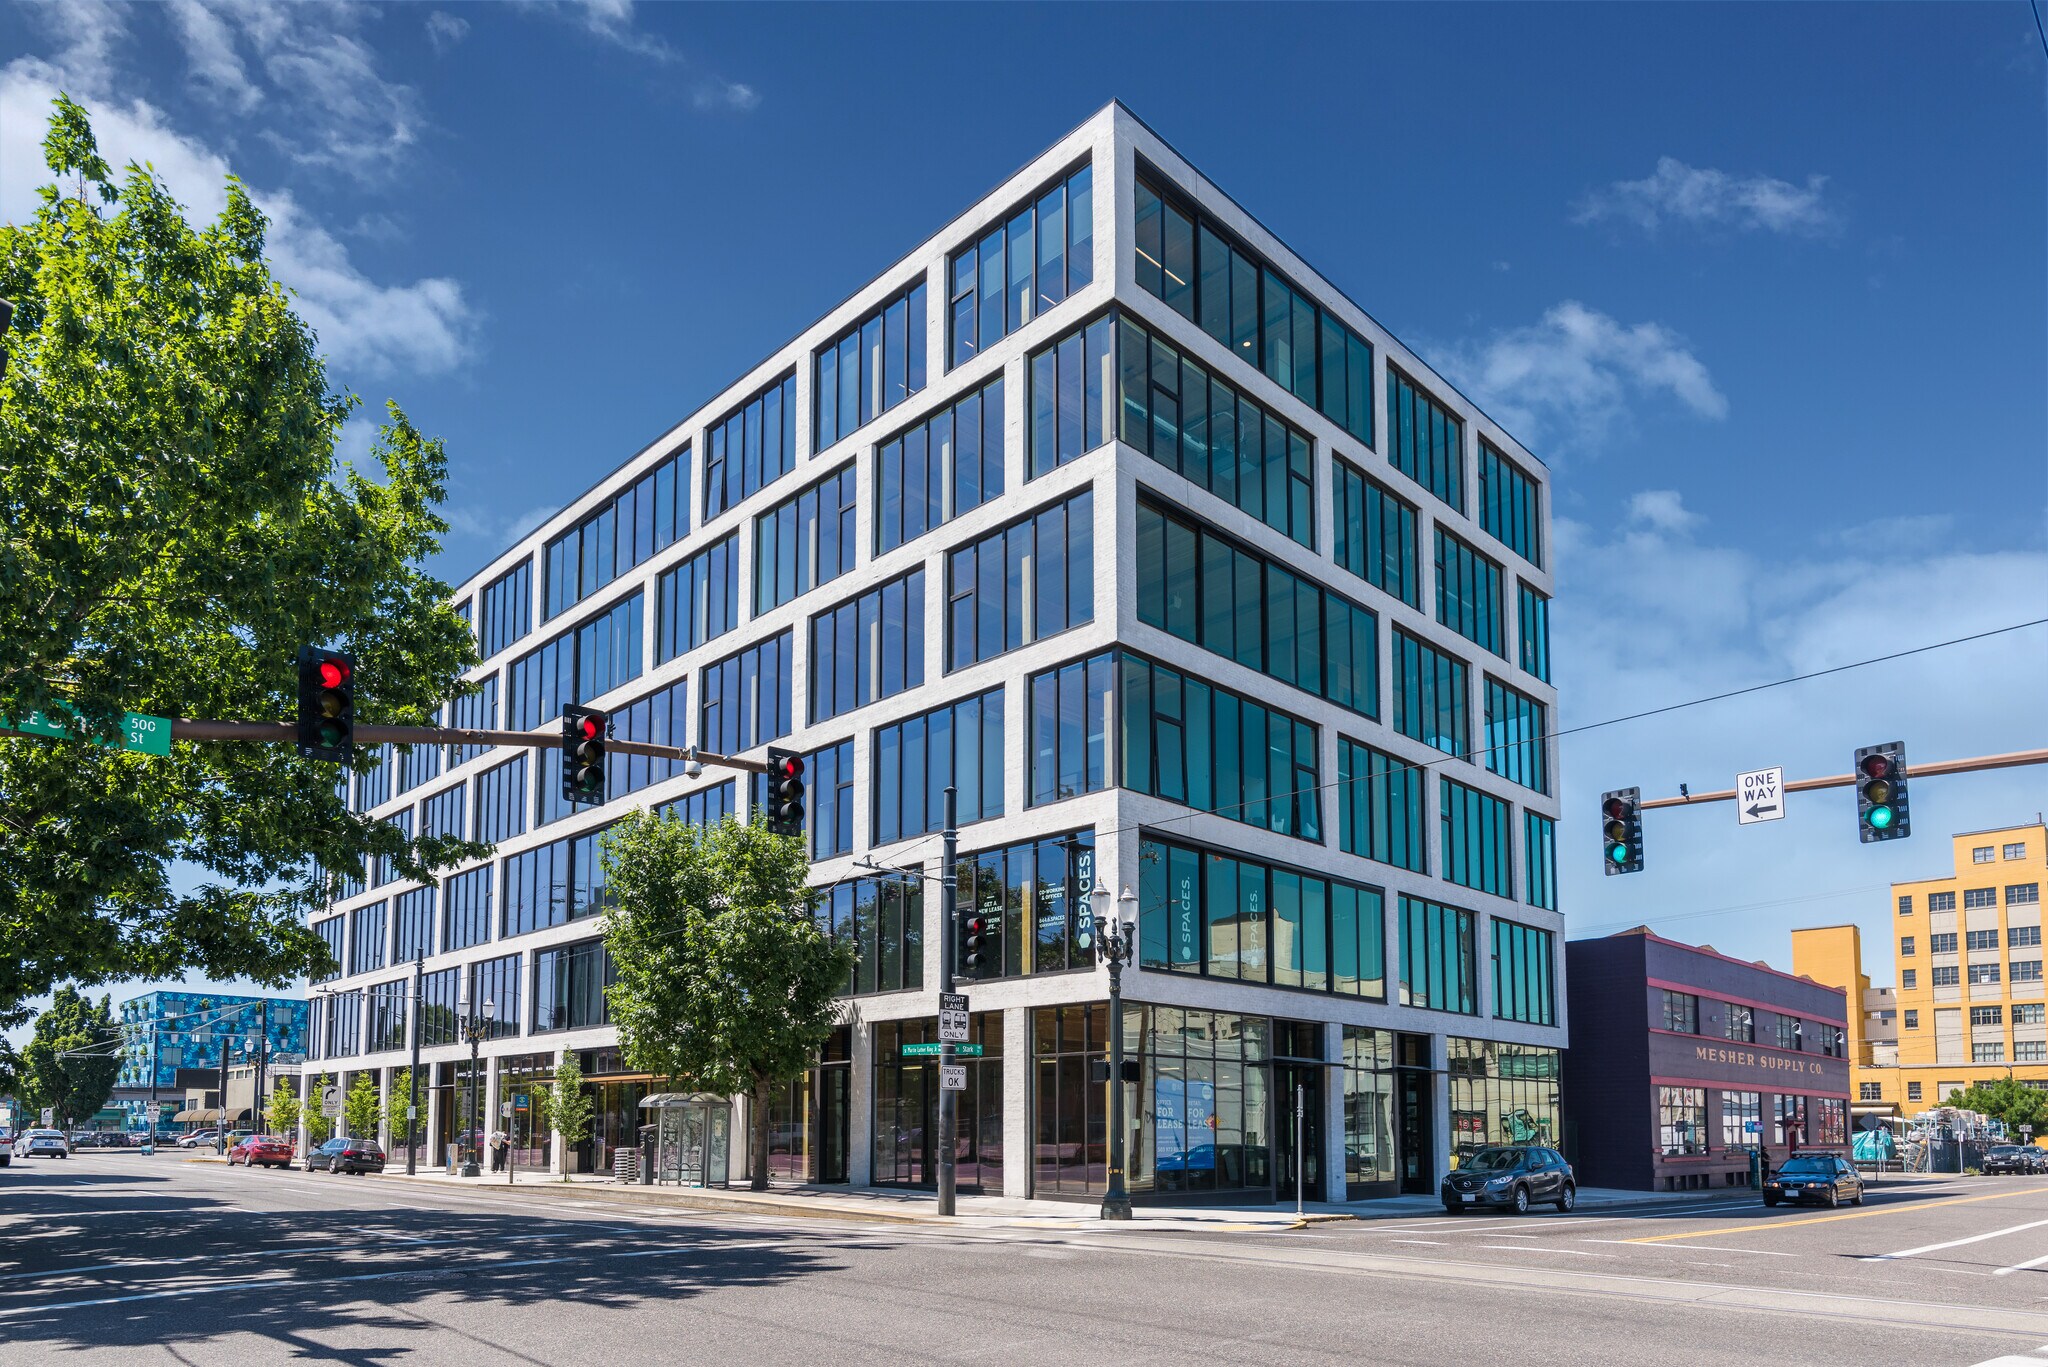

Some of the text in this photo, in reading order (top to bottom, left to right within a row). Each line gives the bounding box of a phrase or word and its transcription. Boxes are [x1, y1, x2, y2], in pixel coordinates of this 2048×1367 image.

[20, 711, 38, 725] E
[130, 732, 144, 745] St
[1745, 772, 1775, 787] ONE
[1744, 785, 1776, 802] WAY
[1078, 850, 1091, 929] SPACES.
[1045, 892, 1063, 900] OFFICES
[988, 905, 1003, 913] LEASE
[1181, 876, 1191, 943] SPACES.
[1249, 890, 1258, 953] SPACES.
[943, 994, 965, 1003] RIGHT
[944, 1002, 964, 1011] LANE
[962, 1045, 974, 1053] Stark
[1696, 1047, 1824, 1075] MESHER SUPPLY CO.
[948, 1077, 960, 1086] OK
[1157, 1107, 1174, 1117] FOR
[1188, 1107, 1205, 1118] FOR
[1157, 1118, 1184, 1129] LEASE
